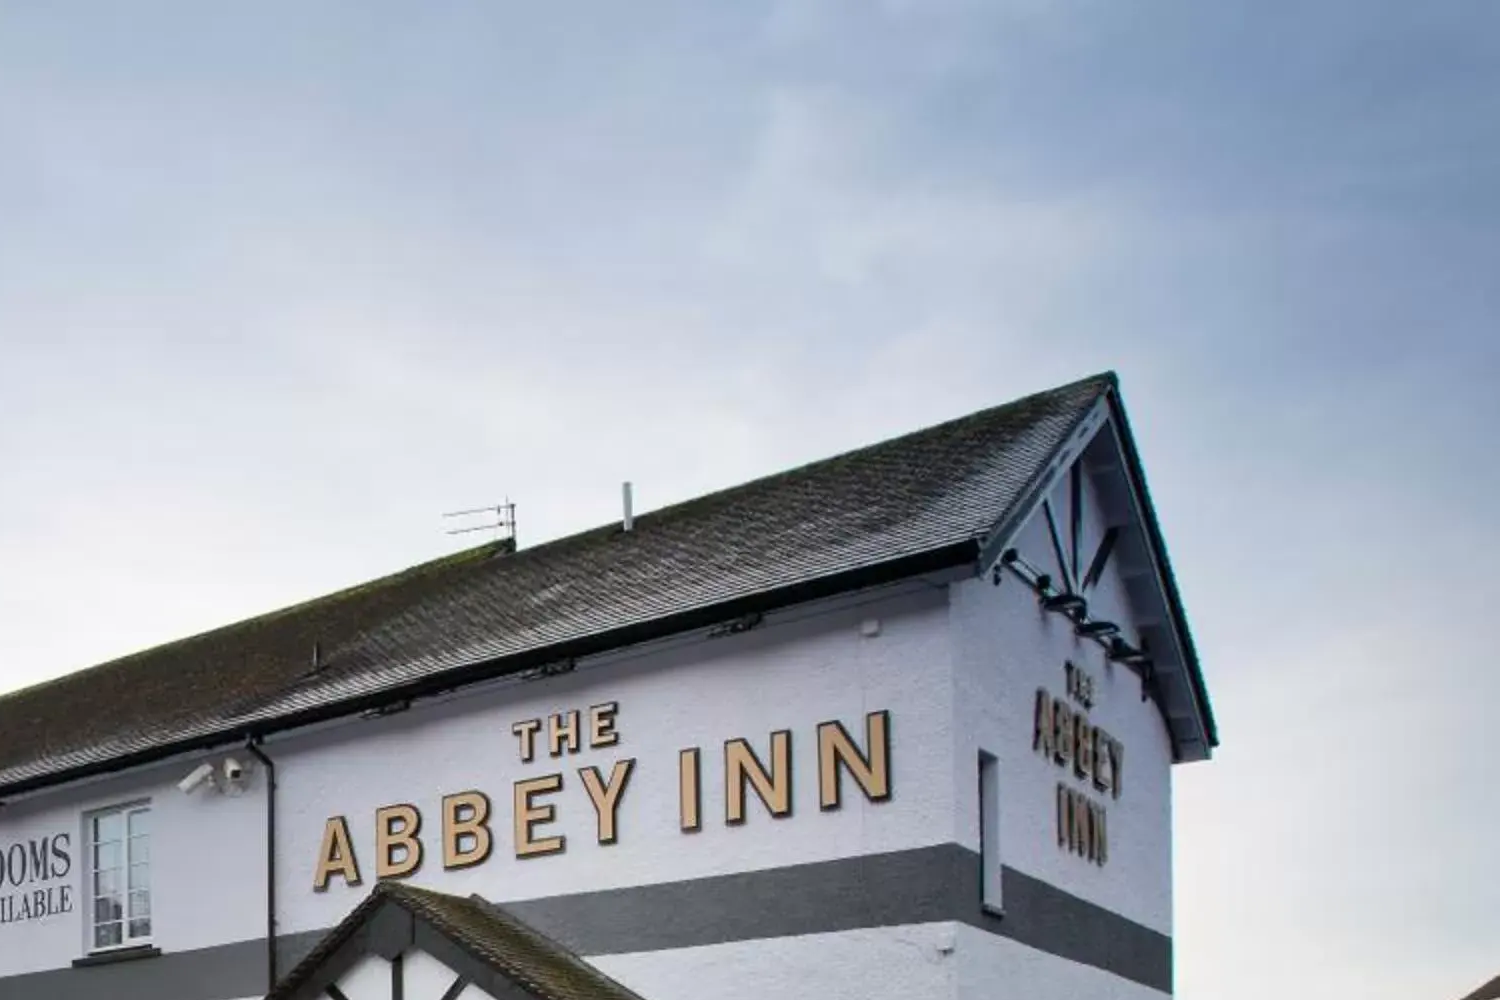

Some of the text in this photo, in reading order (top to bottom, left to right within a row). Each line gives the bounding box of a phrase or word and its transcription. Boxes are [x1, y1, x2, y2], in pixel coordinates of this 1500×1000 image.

[512, 702, 621, 763] THE
[313, 709, 891, 892] ABBEY INN
